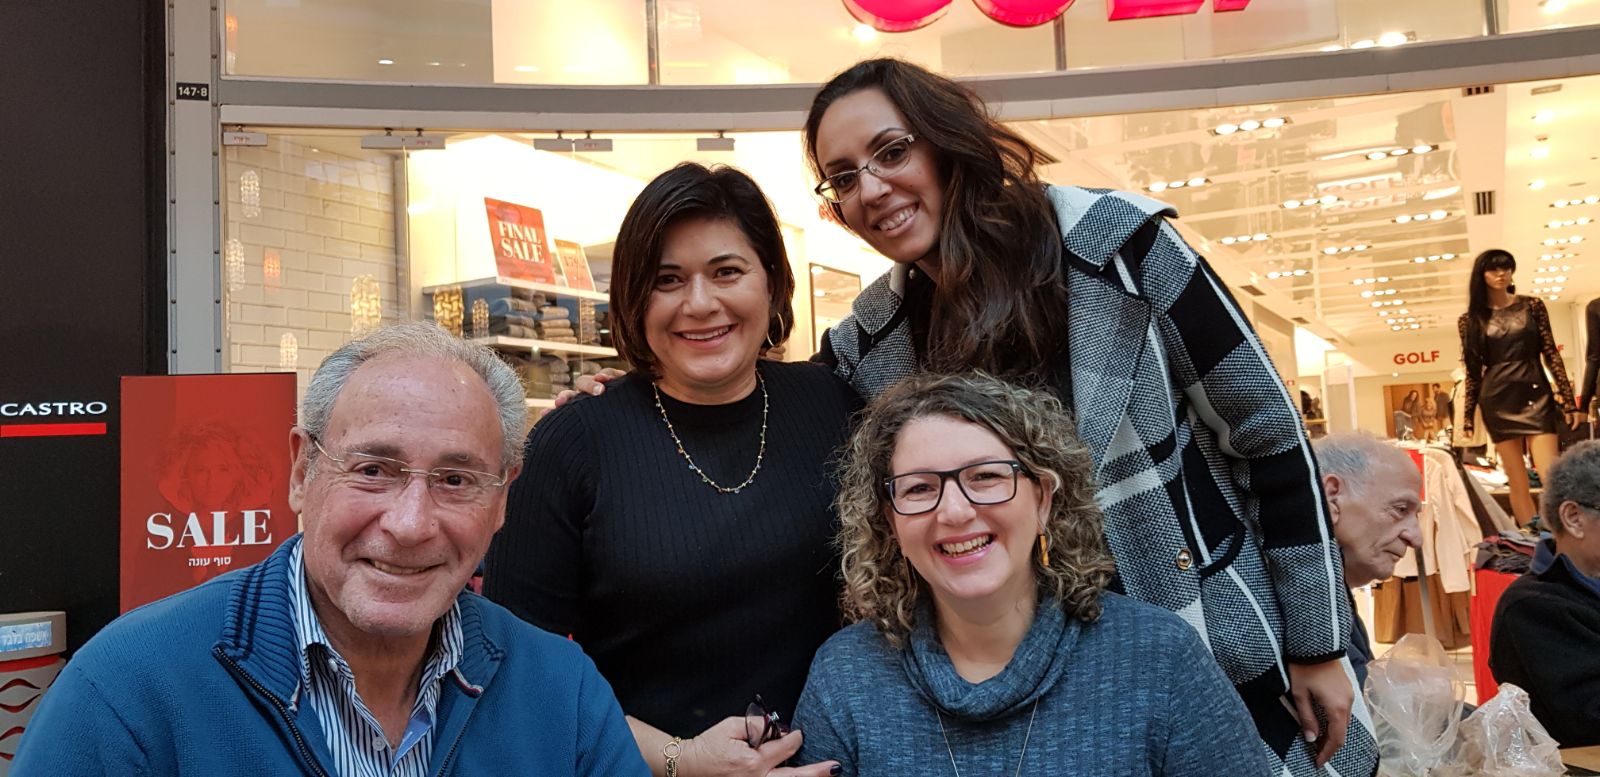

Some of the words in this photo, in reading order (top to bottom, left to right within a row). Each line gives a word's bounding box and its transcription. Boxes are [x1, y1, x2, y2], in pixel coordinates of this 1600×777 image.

[498, 221, 542, 245] FINAL
[500, 238, 545, 264] SALE
[1393, 350, 1440, 365] GOLF
[0, 401, 107, 416] CASTRO
[146, 509, 272, 550] SALE
[188, 556, 211, 567] עונה
[213, 556, 232, 567] סוף
